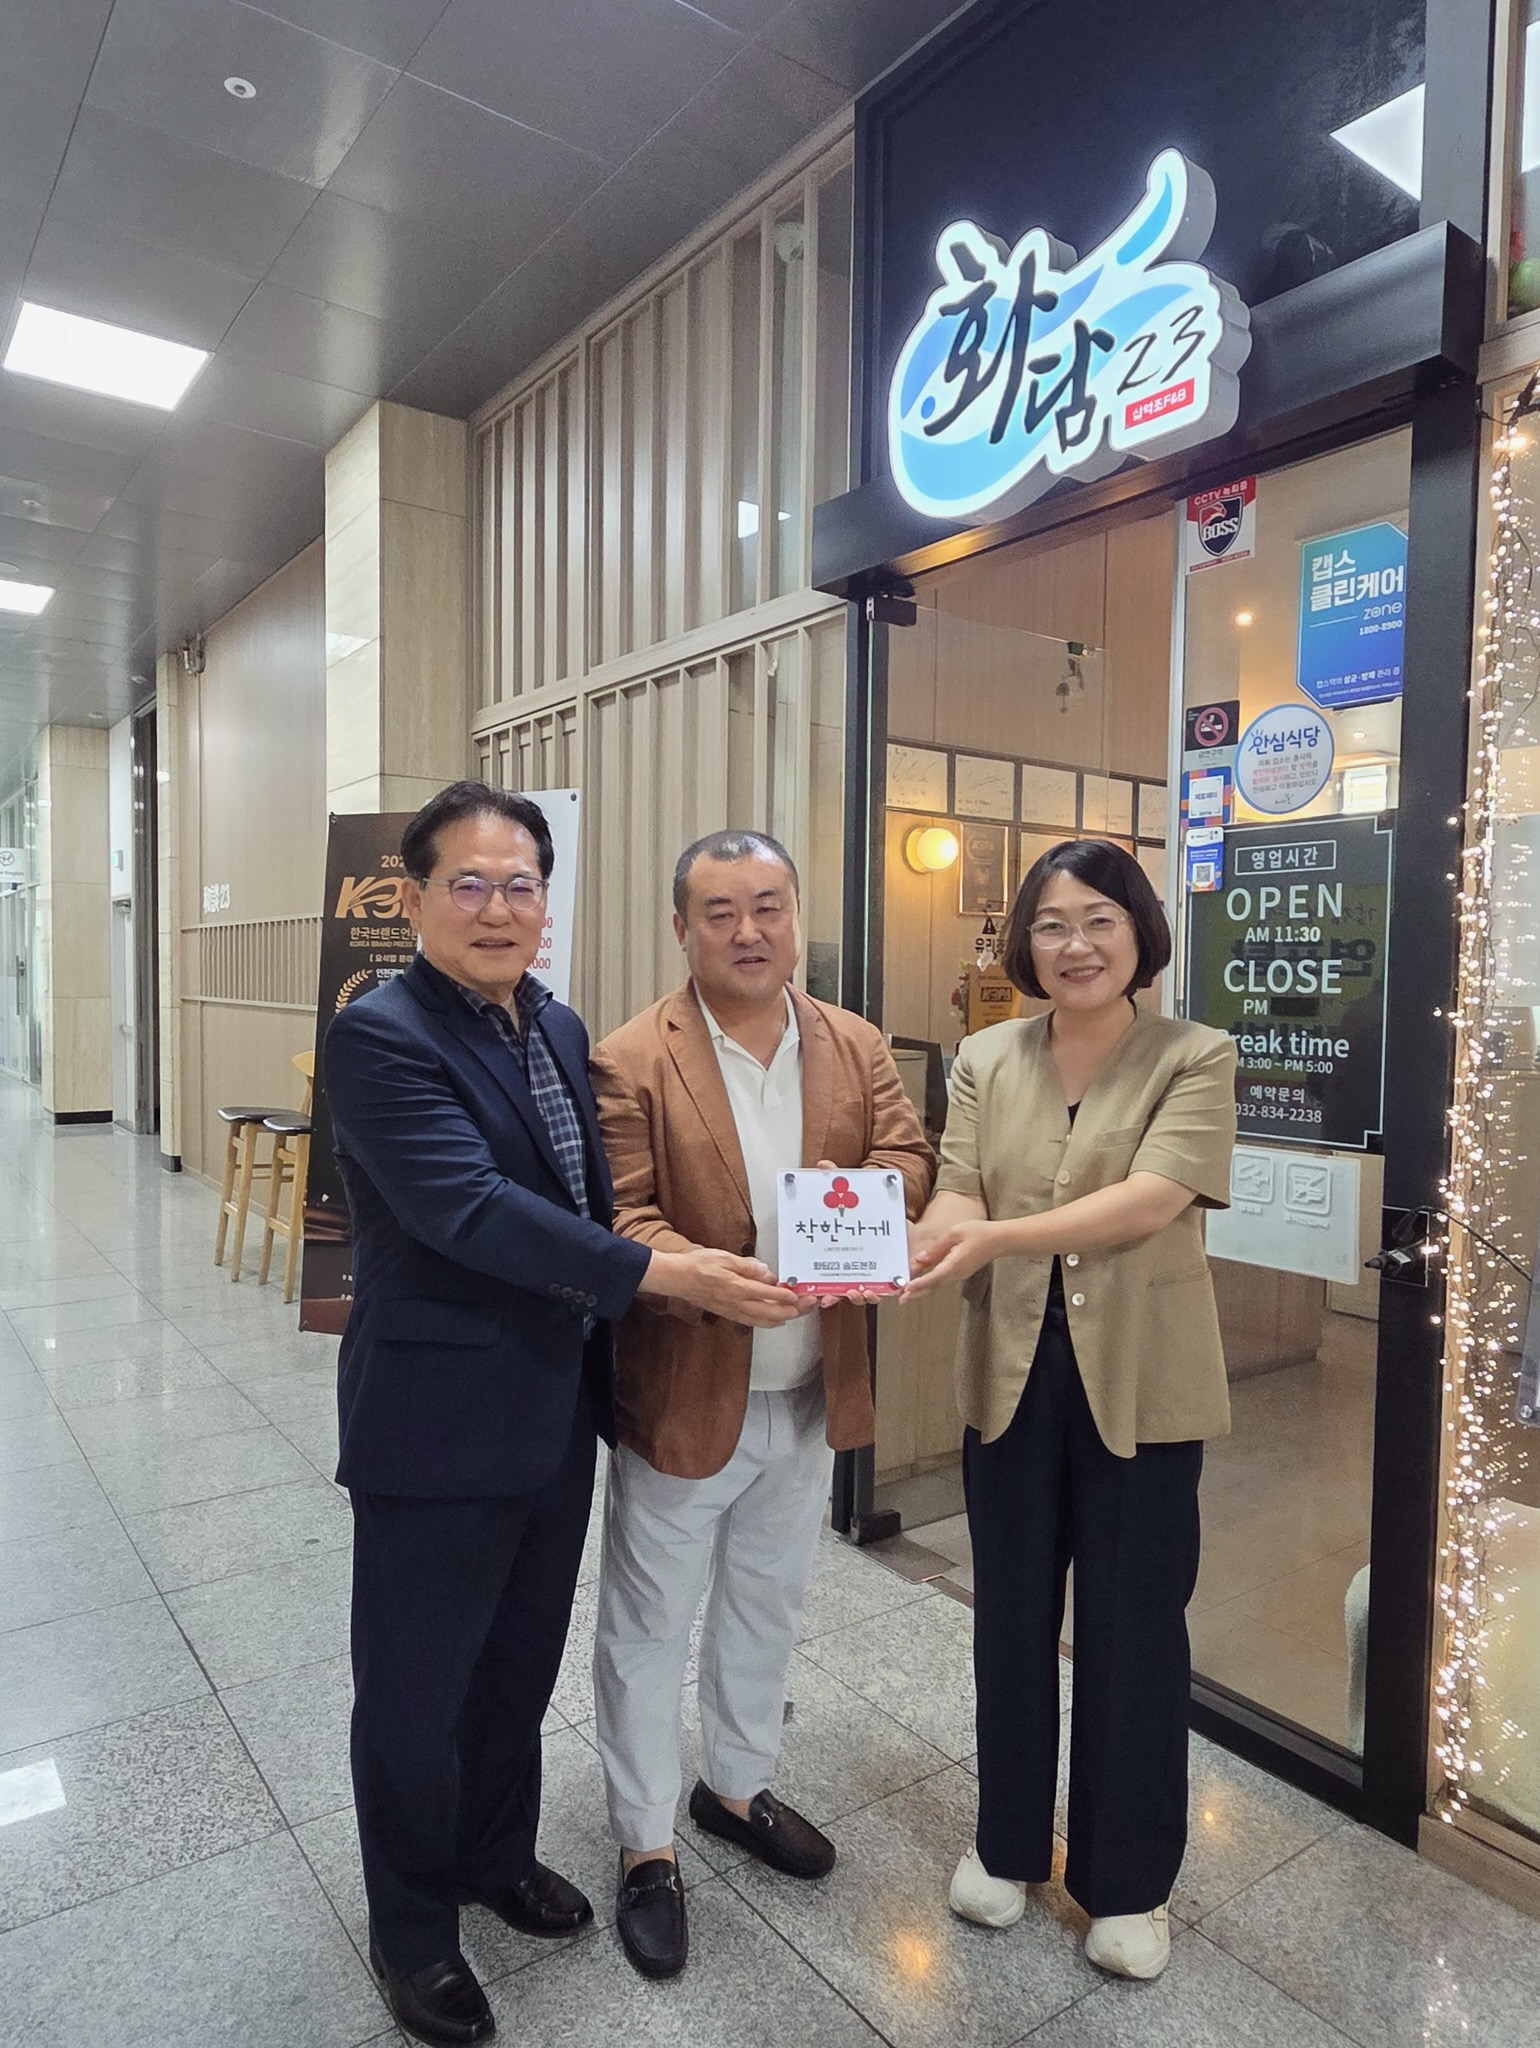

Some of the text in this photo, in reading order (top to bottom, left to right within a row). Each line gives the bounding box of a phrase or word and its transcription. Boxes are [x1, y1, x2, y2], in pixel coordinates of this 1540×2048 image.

[1194, 489, 1221, 505] CCTV
[1202, 517, 1239, 541] BOSS
[1311, 549, 1356, 582] 캡스
[1309, 565, 1404, 612] 클린케어
[1363, 601, 1403, 620] zone
[1250, 726, 1320, 755] 안심식당
[380, 855, 405, 868] 202
[1251, 846, 1319, 870] 영업시간
[1226, 882, 1344, 921] OPEN
[1244, 926, 1322, 943] AM 11:30
[1223, 959, 1343, 994] CLOSE
[1243, 999, 1268, 1015] PM
[1222, 1029, 1350, 1059] reak time
[1247, 1057, 1272, 1070] 3:00
[1284, 1059, 1303, 1072] PM
[1306, 1060, 1334, 1075] 5:00
[1249, 1085, 1305, 1104] 예약문의
[1235, 1103, 1322, 1124] 032-834-2238
[795, 1218, 890, 1243] 착한가게
